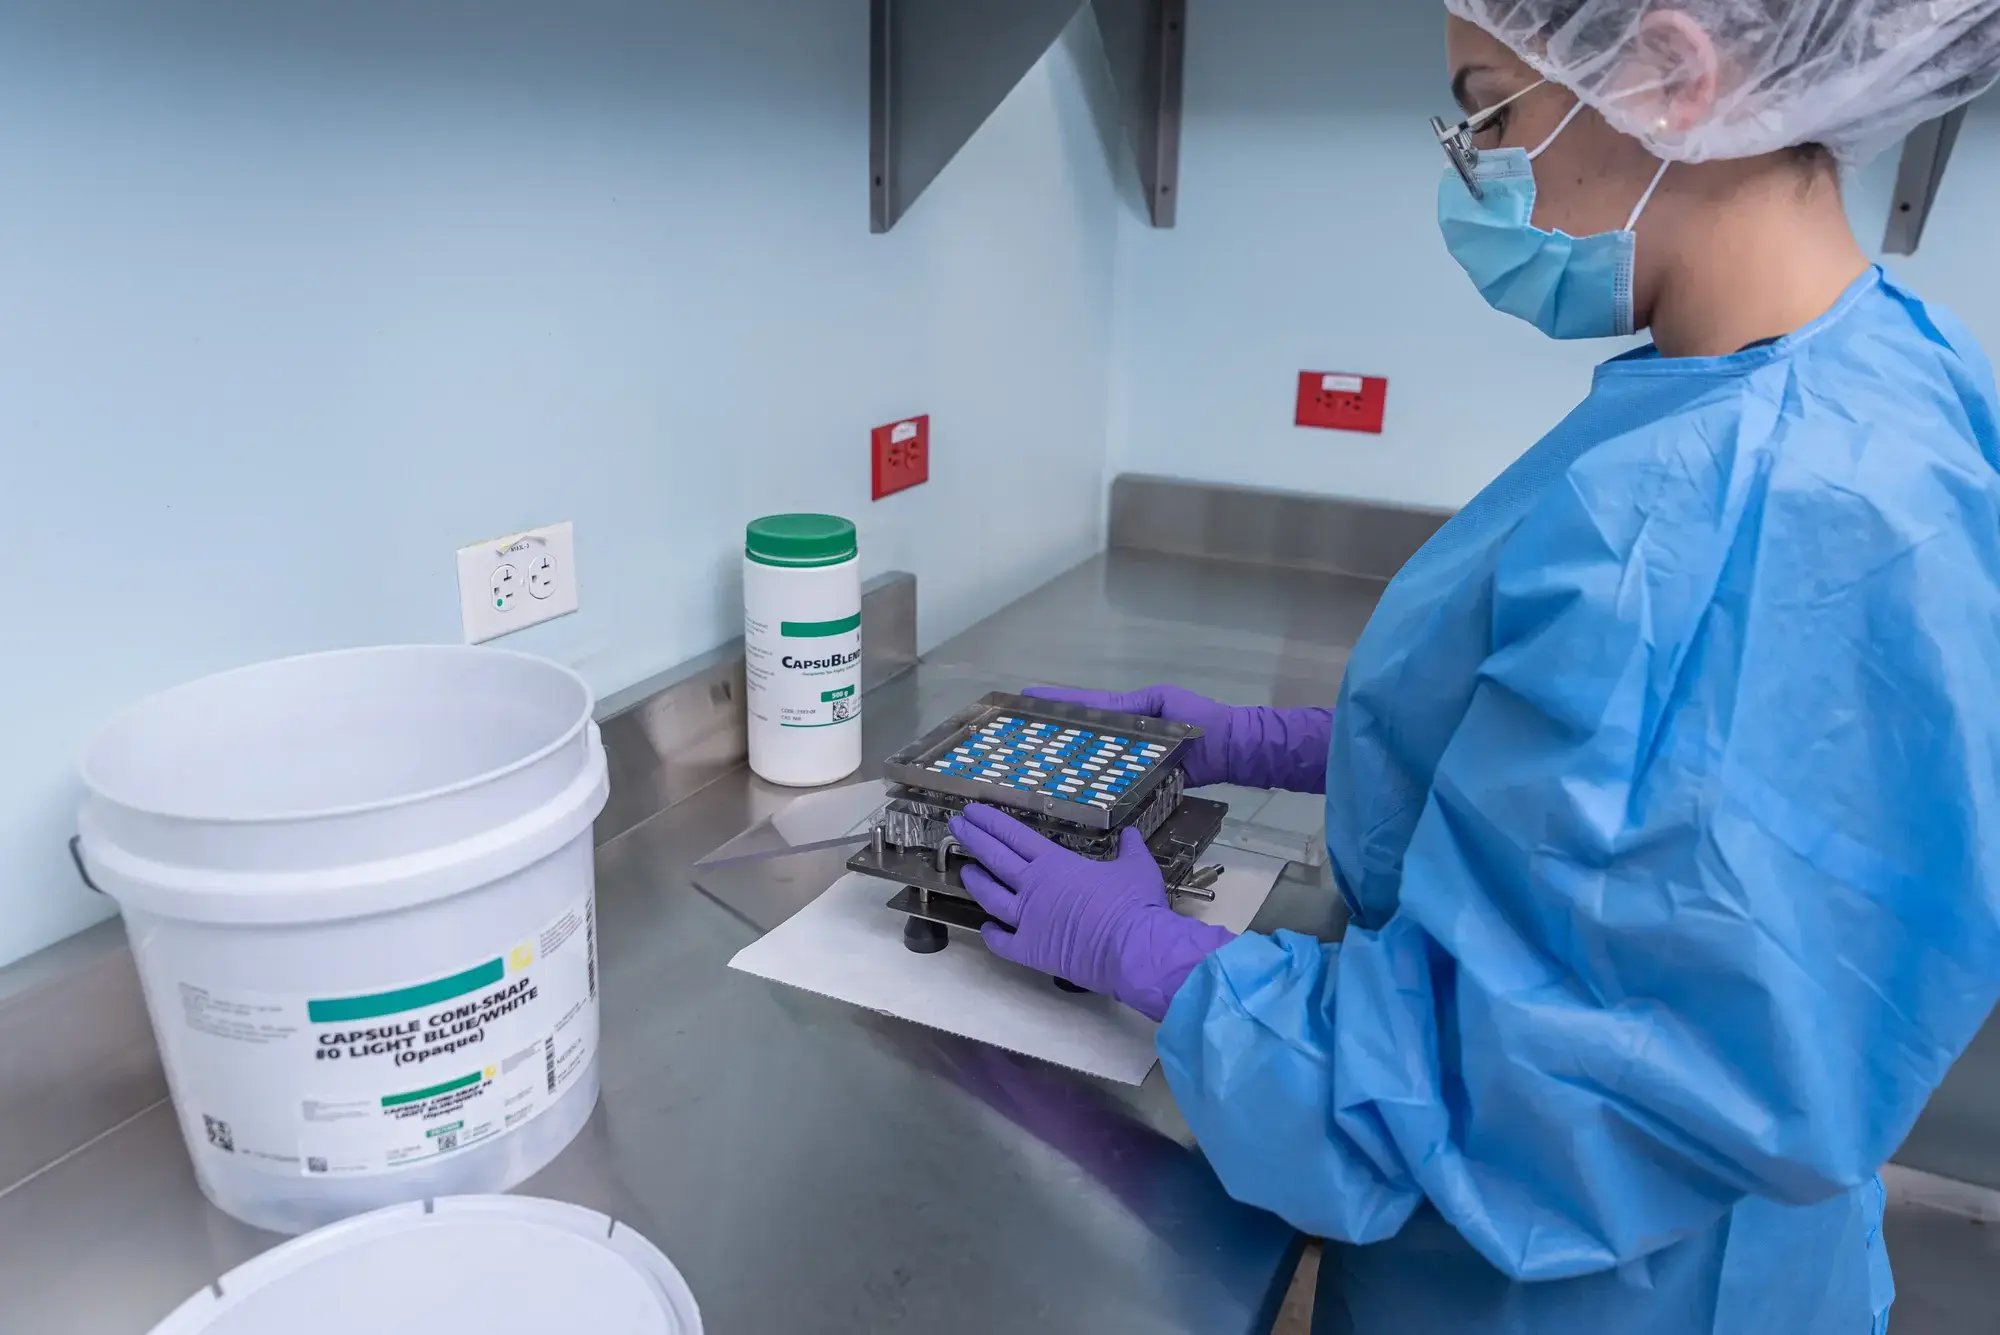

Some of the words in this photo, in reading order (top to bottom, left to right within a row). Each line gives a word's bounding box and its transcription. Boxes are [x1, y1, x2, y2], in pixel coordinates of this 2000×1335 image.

[832, 691, 844, 699] 500
[319, 1019, 420, 1045] CAPSULE
[428, 977, 530, 1027] CONI-SNAP
[349, 1035, 416, 1058] LIGHT
[424, 986, 539, 1044] BLUE/WHITE
[395, 1027, 485, 1067] (Opaque)
